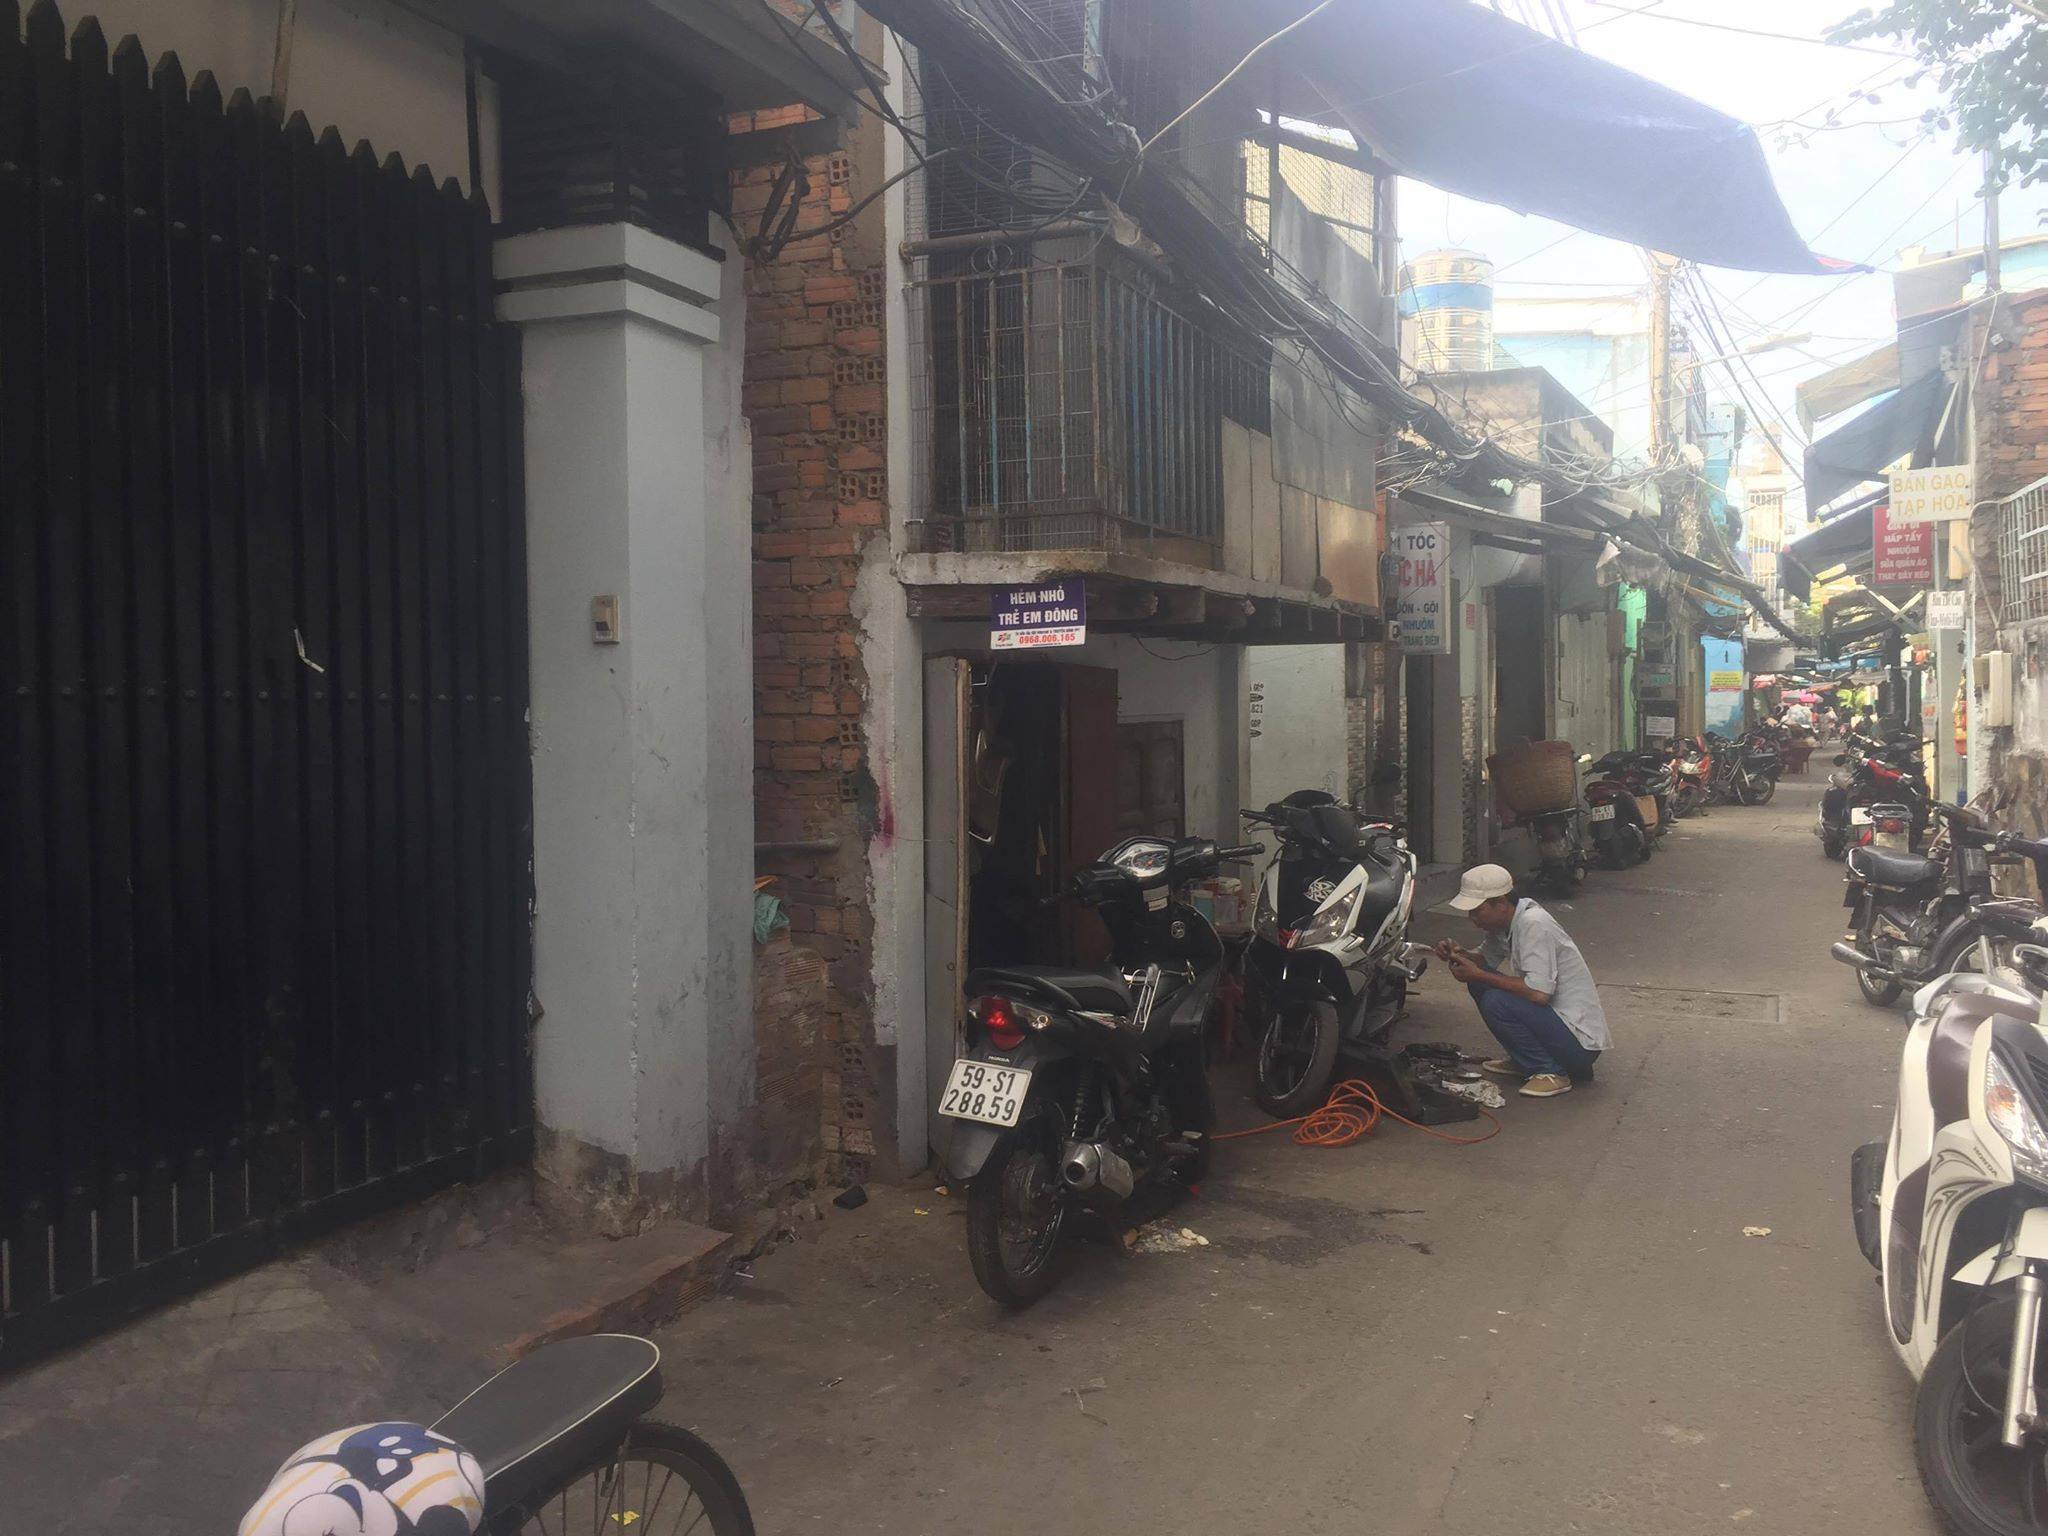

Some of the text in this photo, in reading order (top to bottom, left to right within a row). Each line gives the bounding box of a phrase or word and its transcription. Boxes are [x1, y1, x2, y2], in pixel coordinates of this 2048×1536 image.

[1407, 531, 1435, 550] TÓC
[1040, 585, 1065, 603] NHỎ
[998, 607, 1079, 625] TRẺ EM ĐÔNG
[945, 1089, 1017, 1121] 288.59
